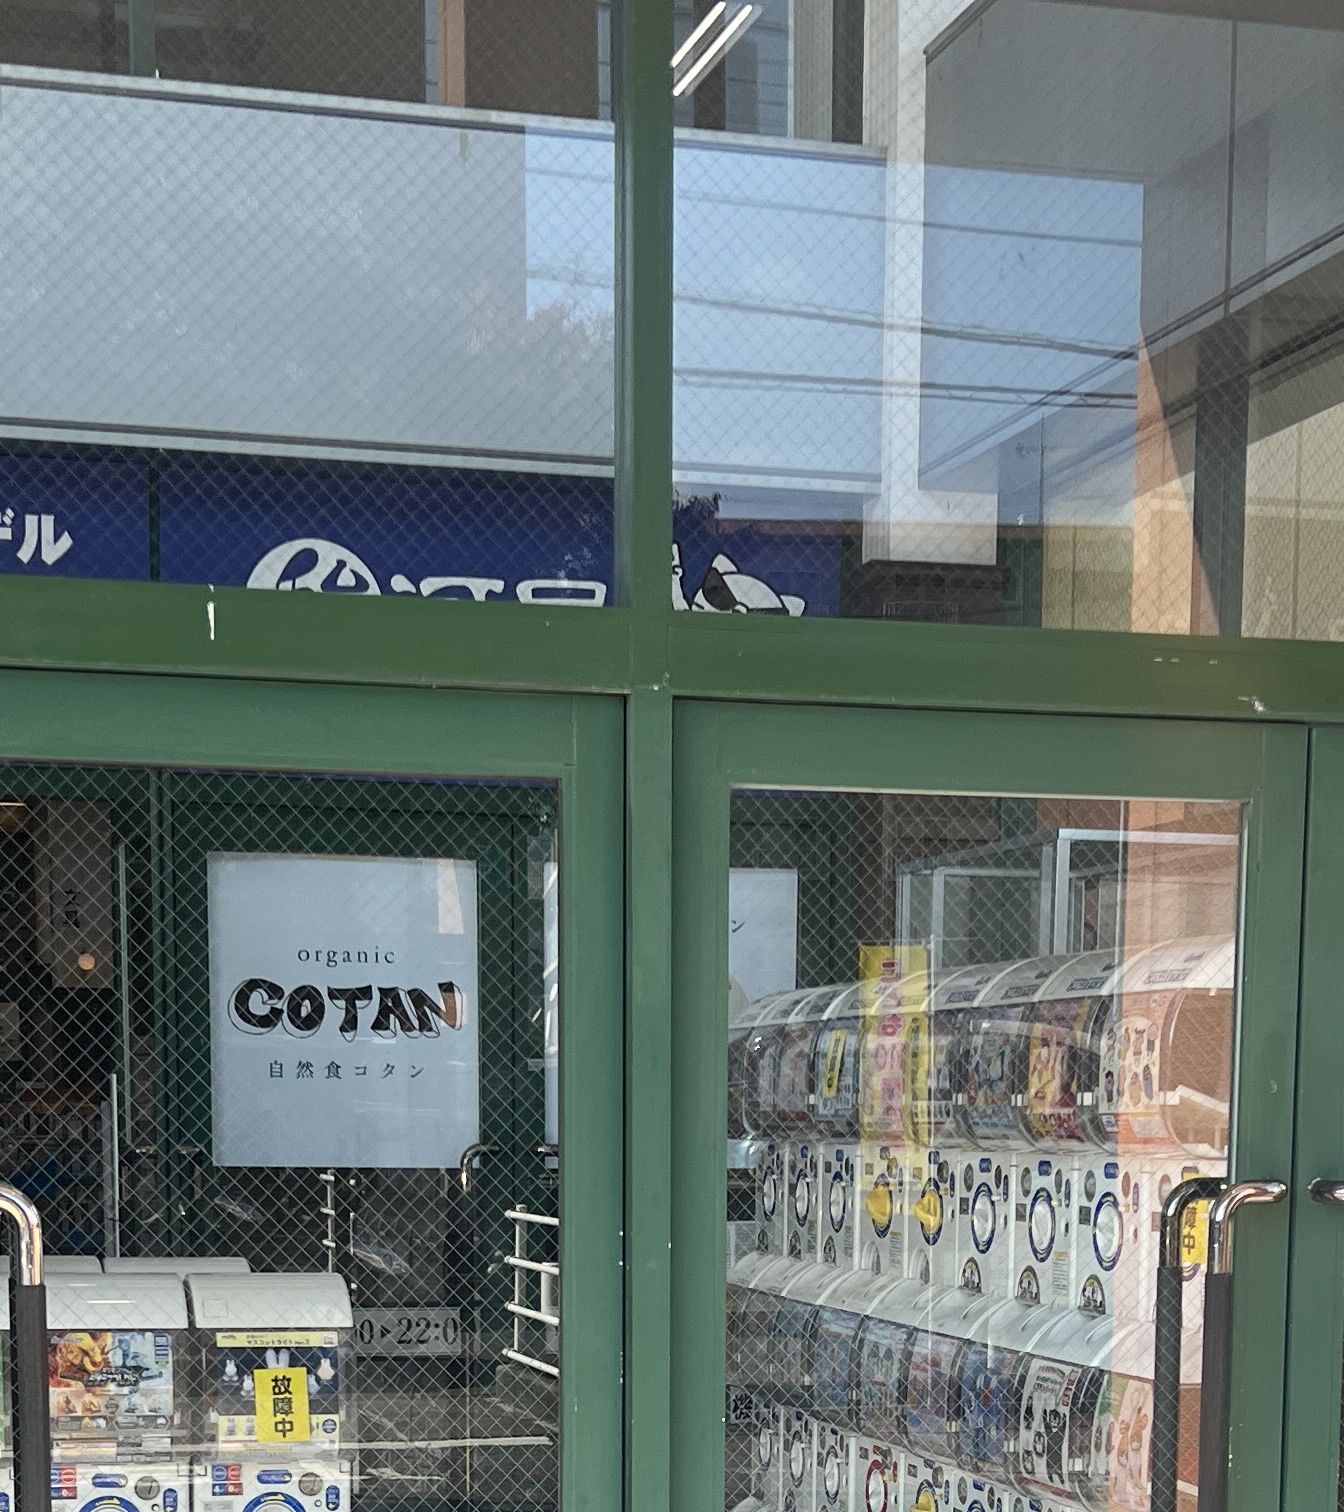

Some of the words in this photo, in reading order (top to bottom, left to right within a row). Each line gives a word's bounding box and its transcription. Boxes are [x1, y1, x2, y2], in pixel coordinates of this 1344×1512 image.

[297, 945, 395, 968] organic
[228, 977, 464, 1042] COTAN
[268, 1059, 425, 1080] 自然食コタン
[396, 1317, 459, 1346] 22:0
[271, 1375, 295, 1439] 故障中
